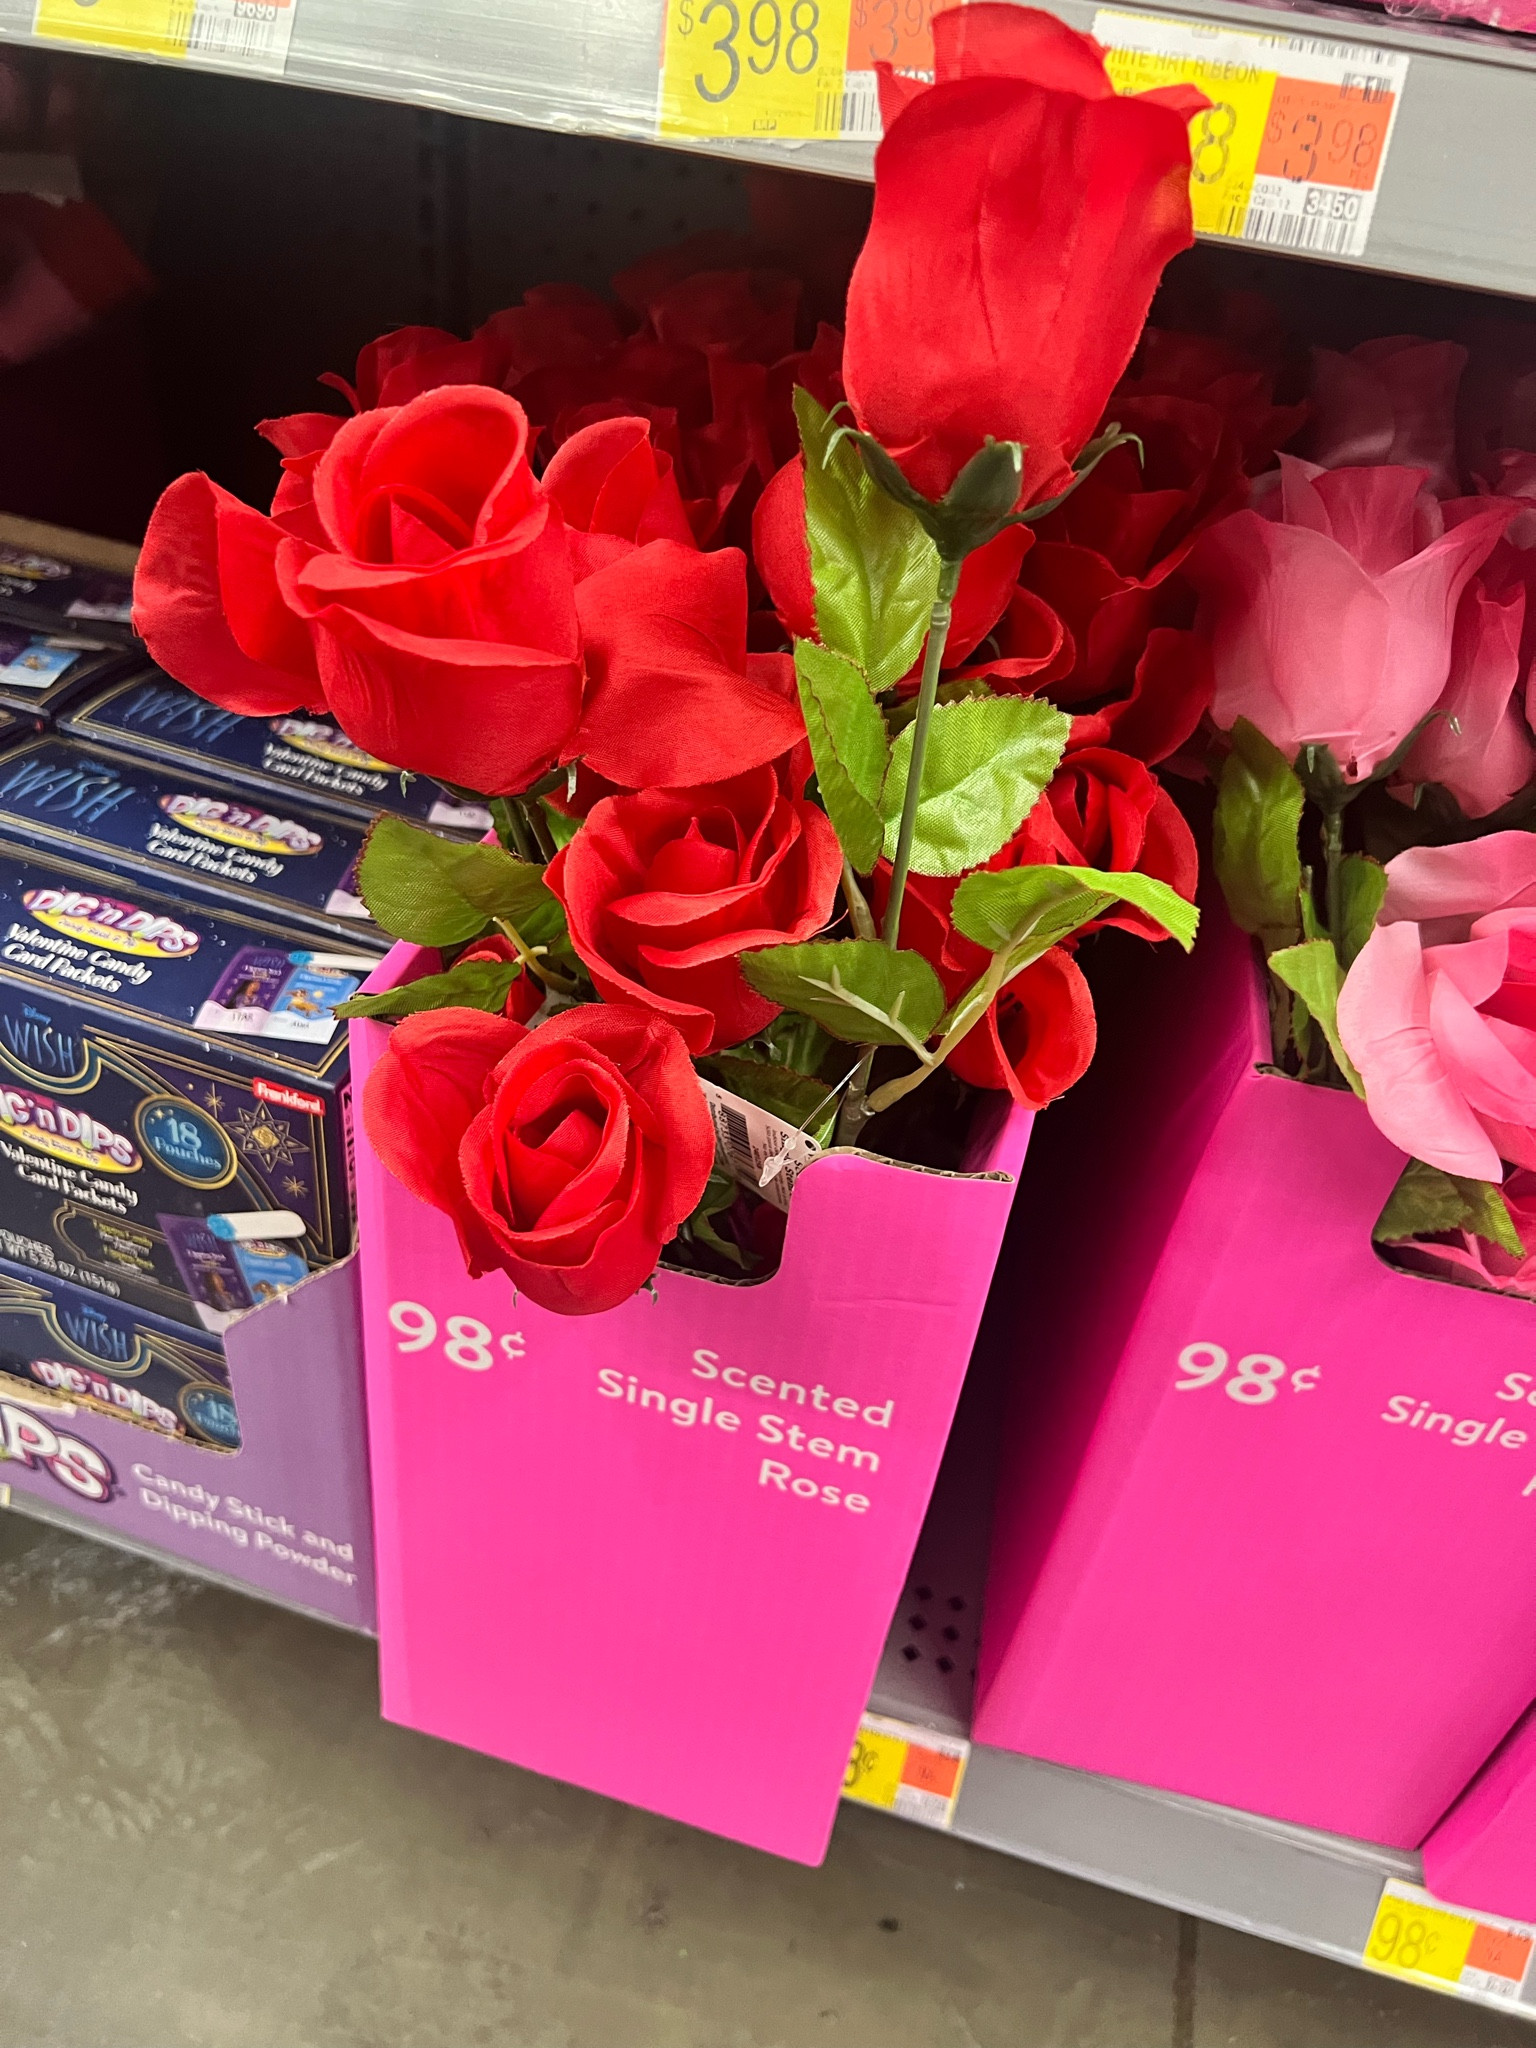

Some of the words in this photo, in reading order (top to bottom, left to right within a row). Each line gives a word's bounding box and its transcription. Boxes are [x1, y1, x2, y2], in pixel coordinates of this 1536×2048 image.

[0, 760, 135, 823] WISH
[147, 839, 195, 863] Card
[224, 847, 284, 877] Candy
[27, 889, 100, 917] DIG
[116, 911, 200, 952] DIPS
[2, 942, 56, 970] Card
[49, 956, 122, 993] Packets
[7, 922, 88, 961] Valentine
[89, 950, 153, 985] Candy
[4, 1014, 76, 1075] WISH
[0, 1089, 31, 1125] IG
[57, 1105, 134, 1166] DIPS
[256, 1081, 323, 1113] Frankford
[152, 1135, 223, 1170] Pouches
[166, 1116, 203, 1151] 18
[16, 1163, 60, 1191] Card
[58, 1178, 128, 1215] Packets
[78, 1169, 139, 1208] Candy
[64, 1311, 129, 1361] WISH
[387, 1300, 528, 1371] 98¢
[36, 1361, 86, 1393] DIG
[109, 1383, 178, 1430] DIPS
[690, 1347, 895, 1428] Scented
[1174, 1341, 1323, 1405] 98¢
[0, 1400, 113, 1499] PS
[596, 1368, 742, 1431] Single
[756, 1413, 882, 1473] Stem
[1380, 1395, 1529, 1450] Single
[131, 1463, 220, 1511] Candy
[226, 1495, 296, 1540] Stick
[302, 1527, 355, 1563] and
[758, 1458, 871, 1513] Rose
[139, 1487, 249, 1547] Dipping
[255, 1531, 358, 1587] Powder
[1370, 1910, 1441, 1970] 98¢
